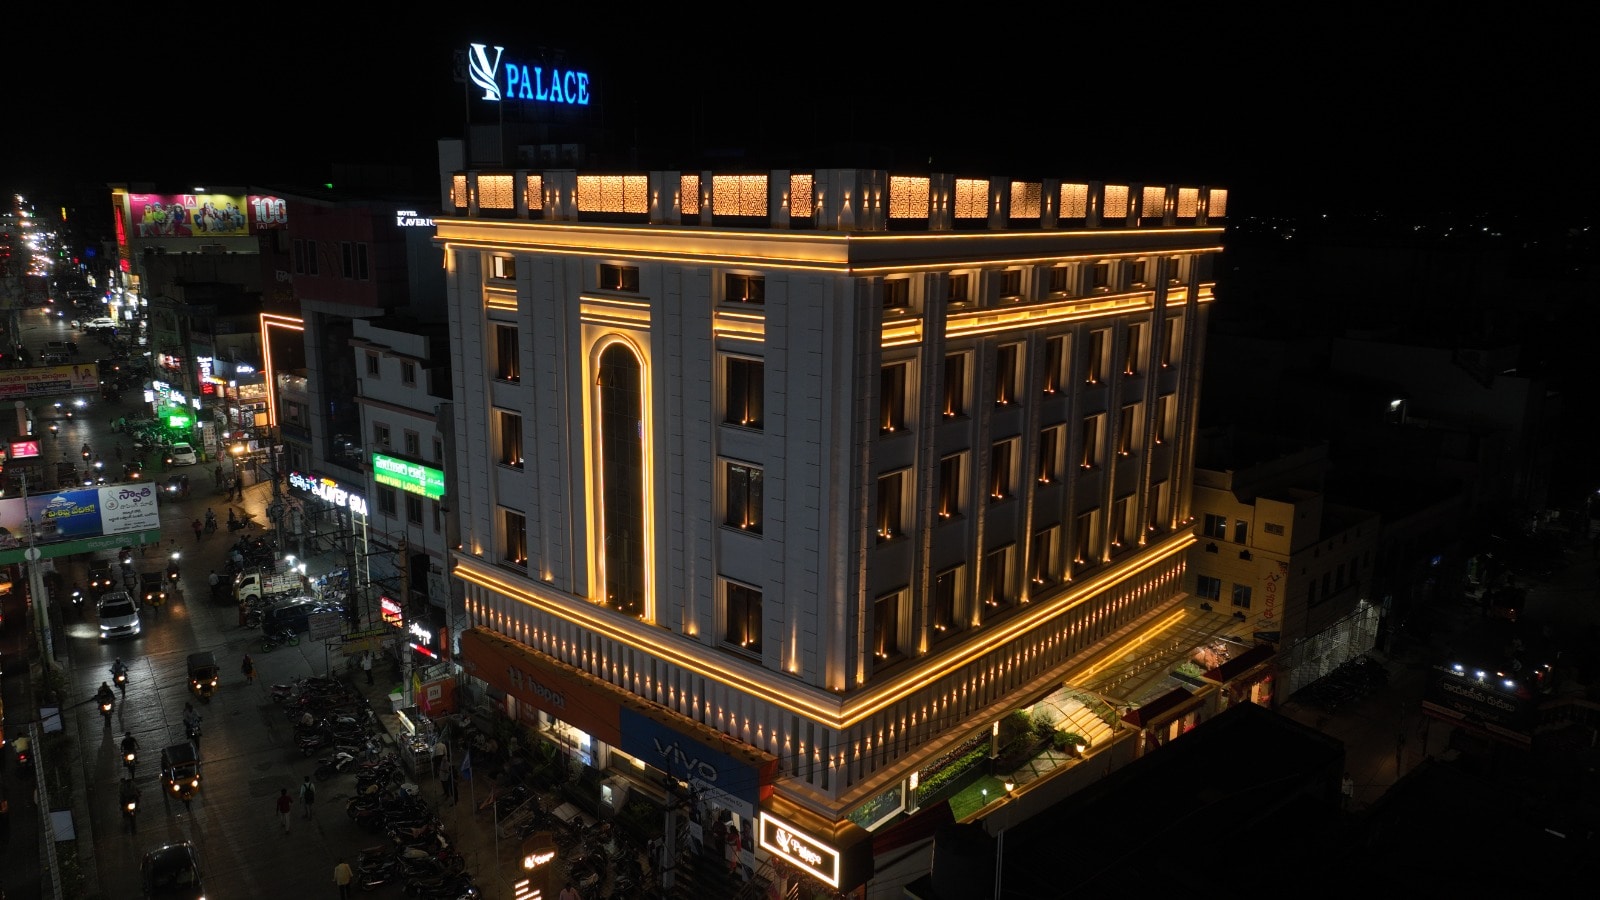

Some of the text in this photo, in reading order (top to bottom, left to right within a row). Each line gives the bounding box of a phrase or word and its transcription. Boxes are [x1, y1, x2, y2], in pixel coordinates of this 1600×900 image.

[505, 63, 589, 105] PALACE
[119, 487, 151, 503] స్వాతి
[376, 473, 402, 488] MAYURI
[402, 480, 426, 495] LODGE
[528, 675, 565, 710] happi
[654, 738, 717, 781] vivo
